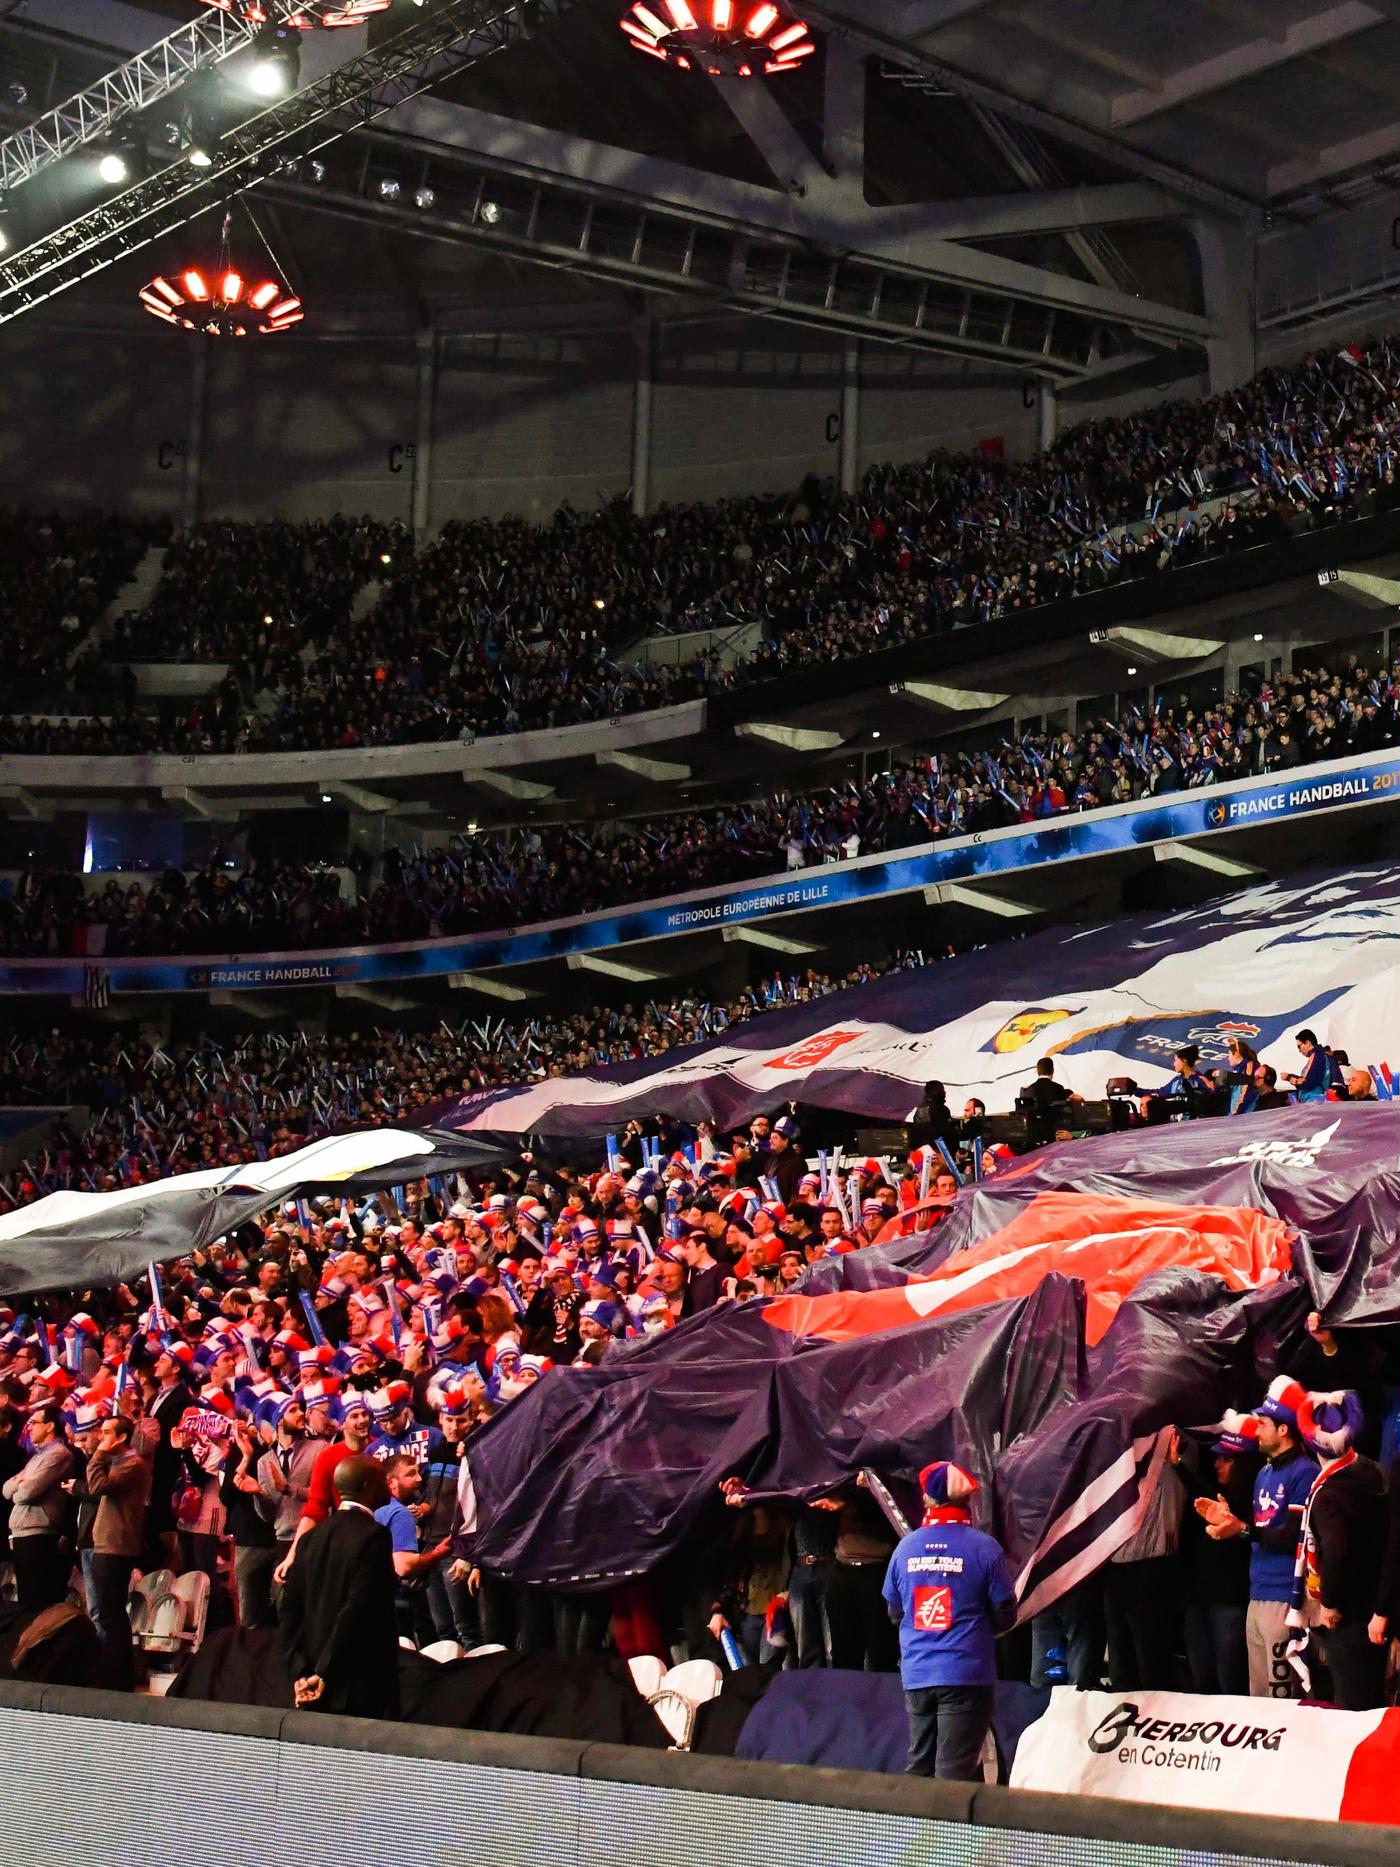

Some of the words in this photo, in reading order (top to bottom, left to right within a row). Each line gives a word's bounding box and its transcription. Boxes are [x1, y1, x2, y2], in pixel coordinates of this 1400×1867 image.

[1230, 794, 1285, 818] FRANCE
[1289, 777, 1369, 806] HANDBALL
[667, 905, 721, 927] MÉTROPOLE
[723, 893, 785, 917] EUROPÉENNE
[787, 889, 800, 904] DE
[802, 885, 829, 901] LILLE
[210, 970, 262, 983] FRANCE
[264, 966, 332, 981] HANDBALL
[907, 1564, 963, 1573] SUPPORTERS
[921, 1557, 937, 1565] EST
[1118, 1747, 1137, 1764] en
[1141, 1745, 1221, 1773] Cotentin
